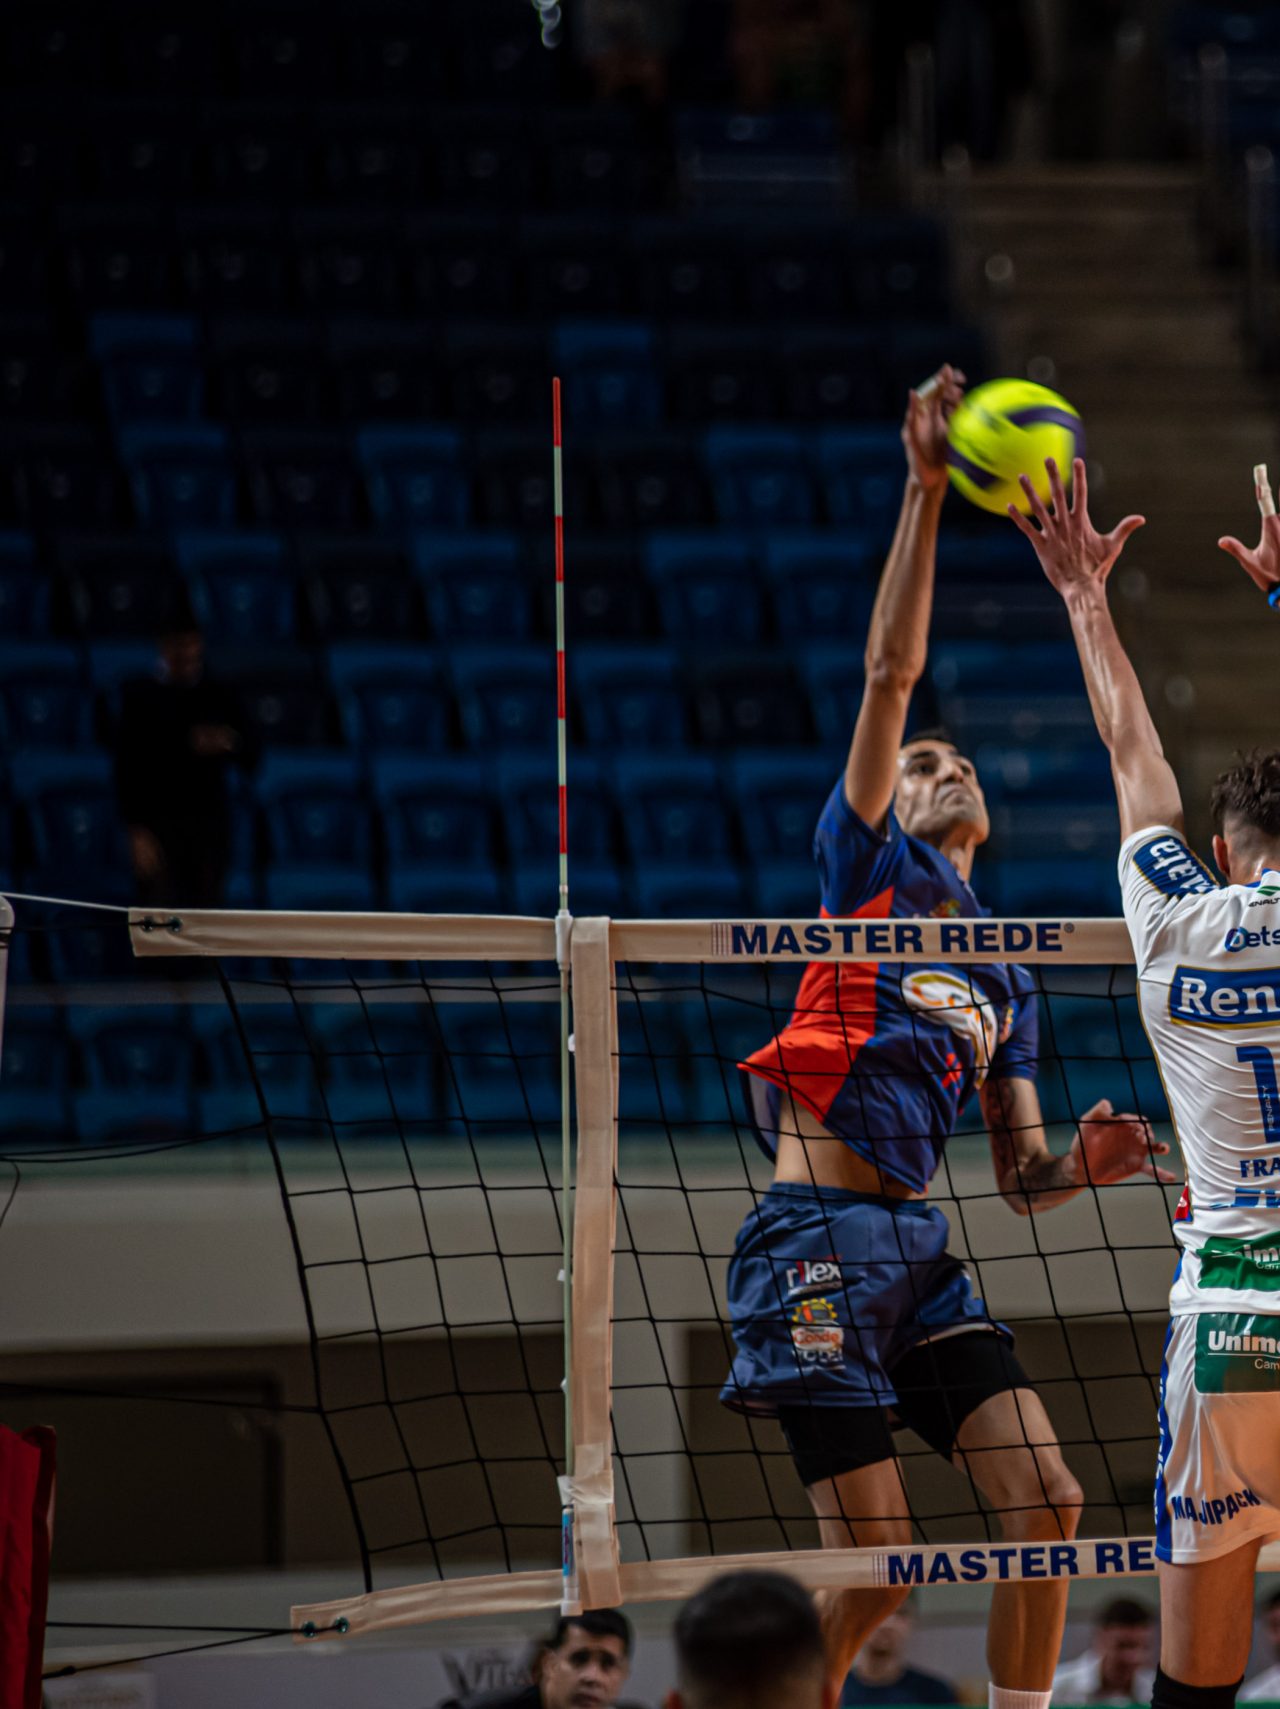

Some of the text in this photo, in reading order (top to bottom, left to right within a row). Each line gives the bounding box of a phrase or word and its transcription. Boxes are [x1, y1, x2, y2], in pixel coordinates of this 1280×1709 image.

[732, 924, 923, 955] MASTER
[1171, 1490, 1261, 1526] MAJIPACK
[888, 1540, 1156, 1586] MASTER RE
